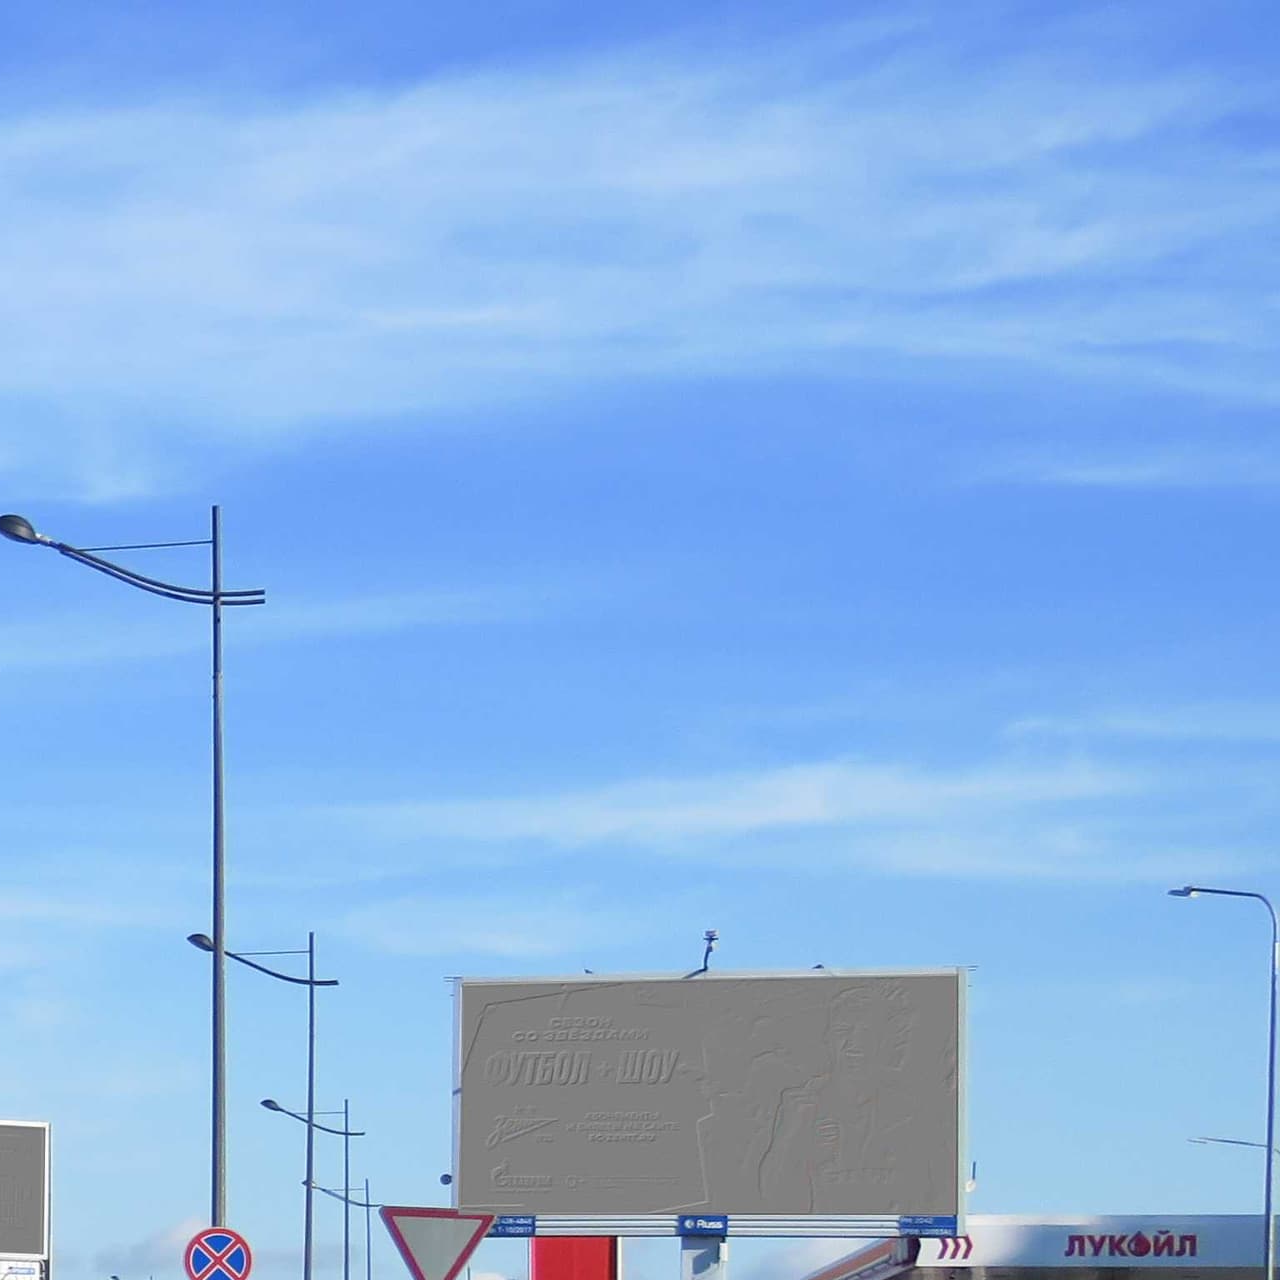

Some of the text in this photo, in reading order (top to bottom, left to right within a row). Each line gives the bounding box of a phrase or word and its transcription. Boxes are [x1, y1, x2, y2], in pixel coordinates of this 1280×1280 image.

[484, 1049, 593, 1087] ФУТБОЛ
[616, 1049, 680, 1087] ШОУ
[696, 1219, 724, 1229] Russ
[1064, 1229, 1197, 1257] ЛУКОЙЛ
